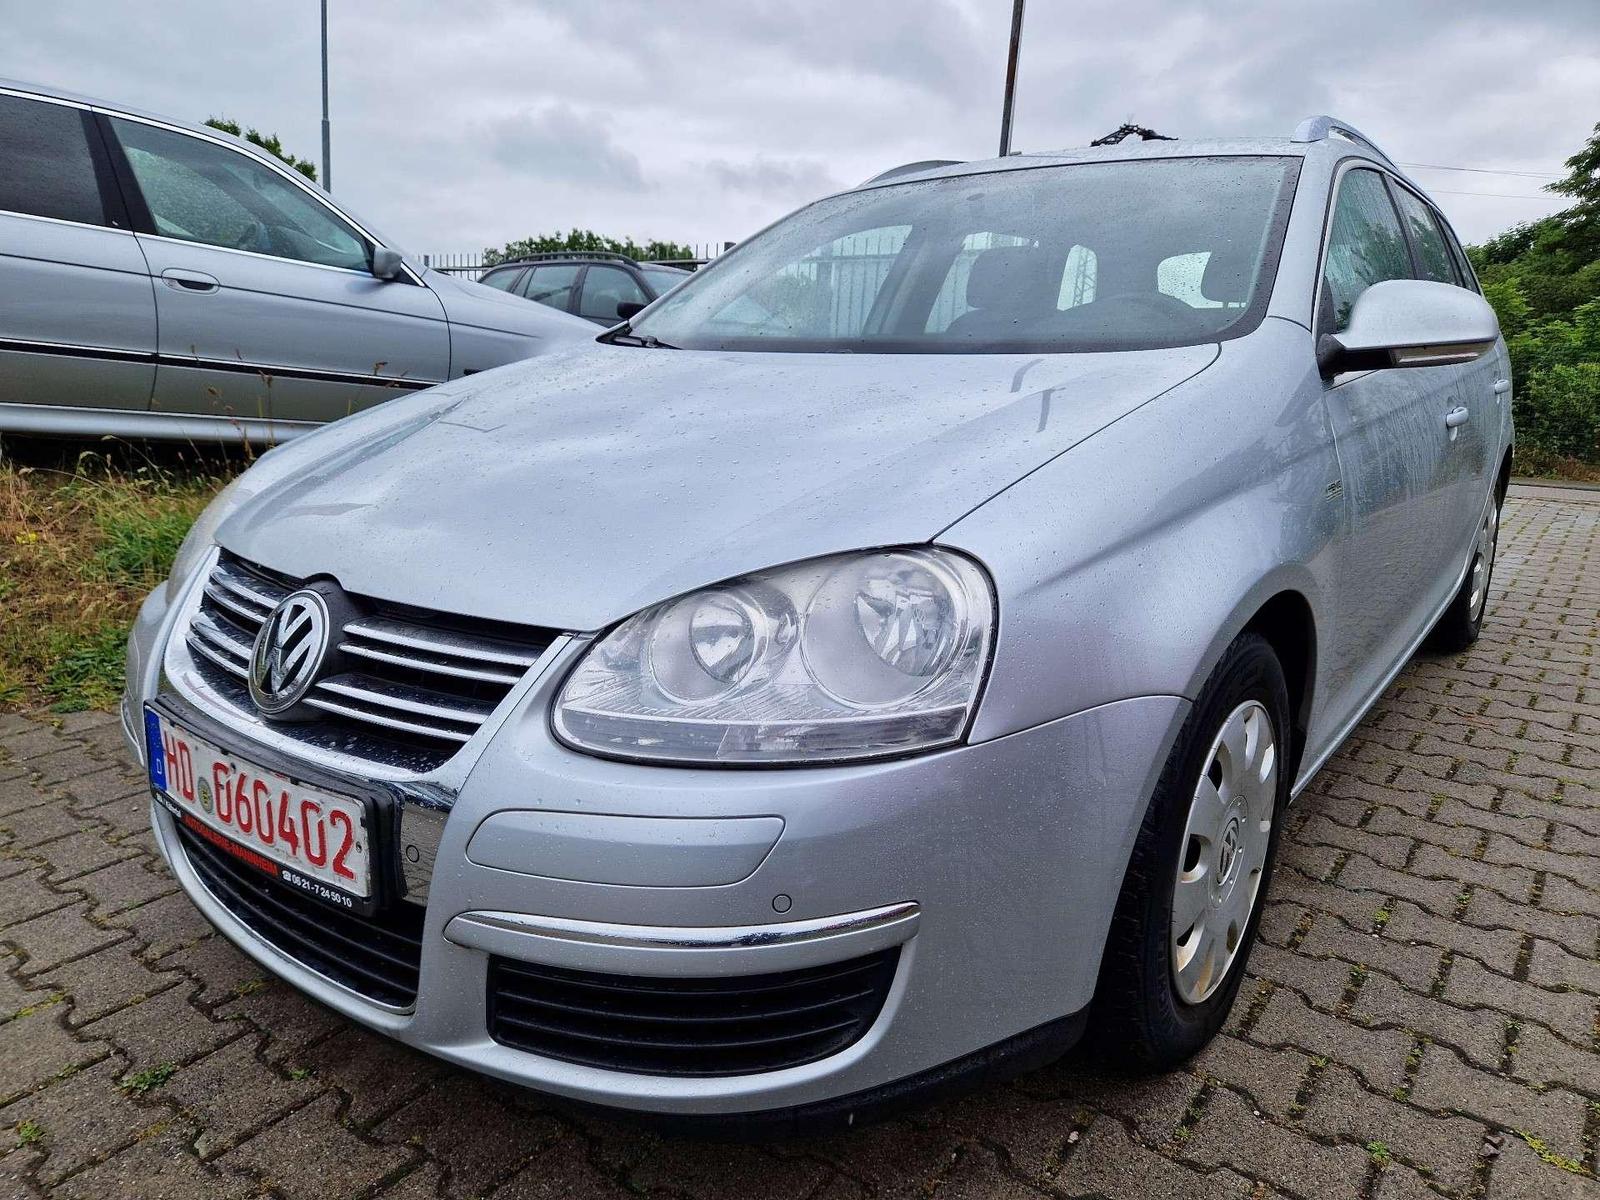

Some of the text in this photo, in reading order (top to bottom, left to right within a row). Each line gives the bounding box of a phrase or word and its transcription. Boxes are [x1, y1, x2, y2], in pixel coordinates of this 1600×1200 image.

[249, 591, 328, 709] VW
[156, 758, 163, 775] D
[163, 730, 355, 880] HD 060402
